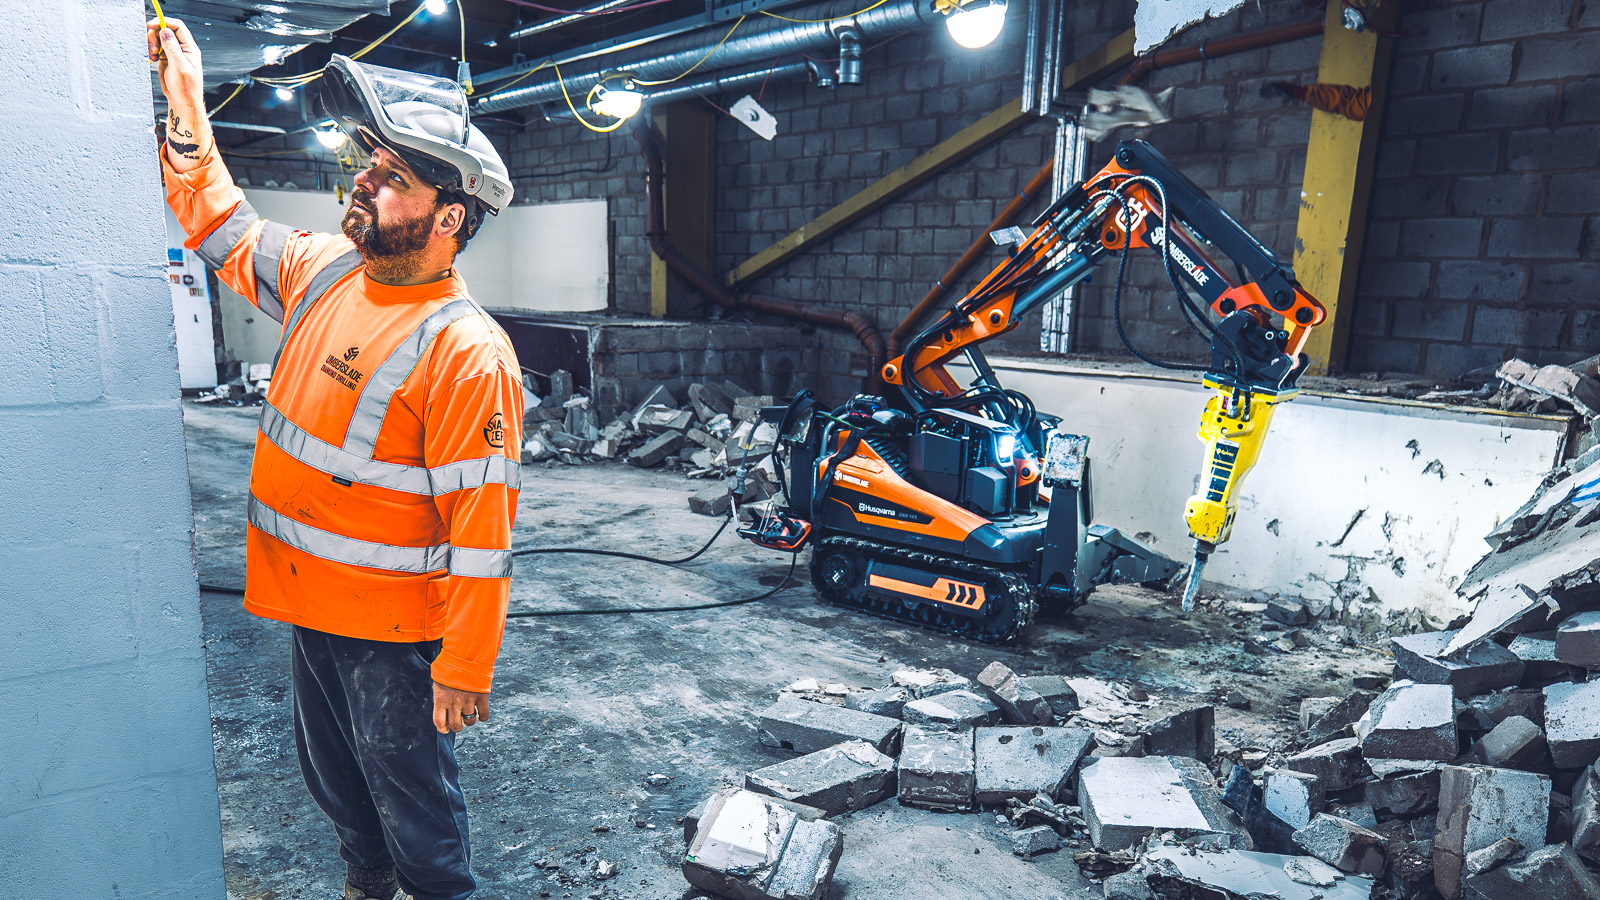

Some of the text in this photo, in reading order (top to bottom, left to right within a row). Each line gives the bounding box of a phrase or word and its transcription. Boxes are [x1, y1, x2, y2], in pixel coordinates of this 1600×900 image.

[325, 354, 364, 383] UMBERSLADE
[335, 373, 357, 391] DRILLING
[865, 504, 896, 517] Husqvarna
